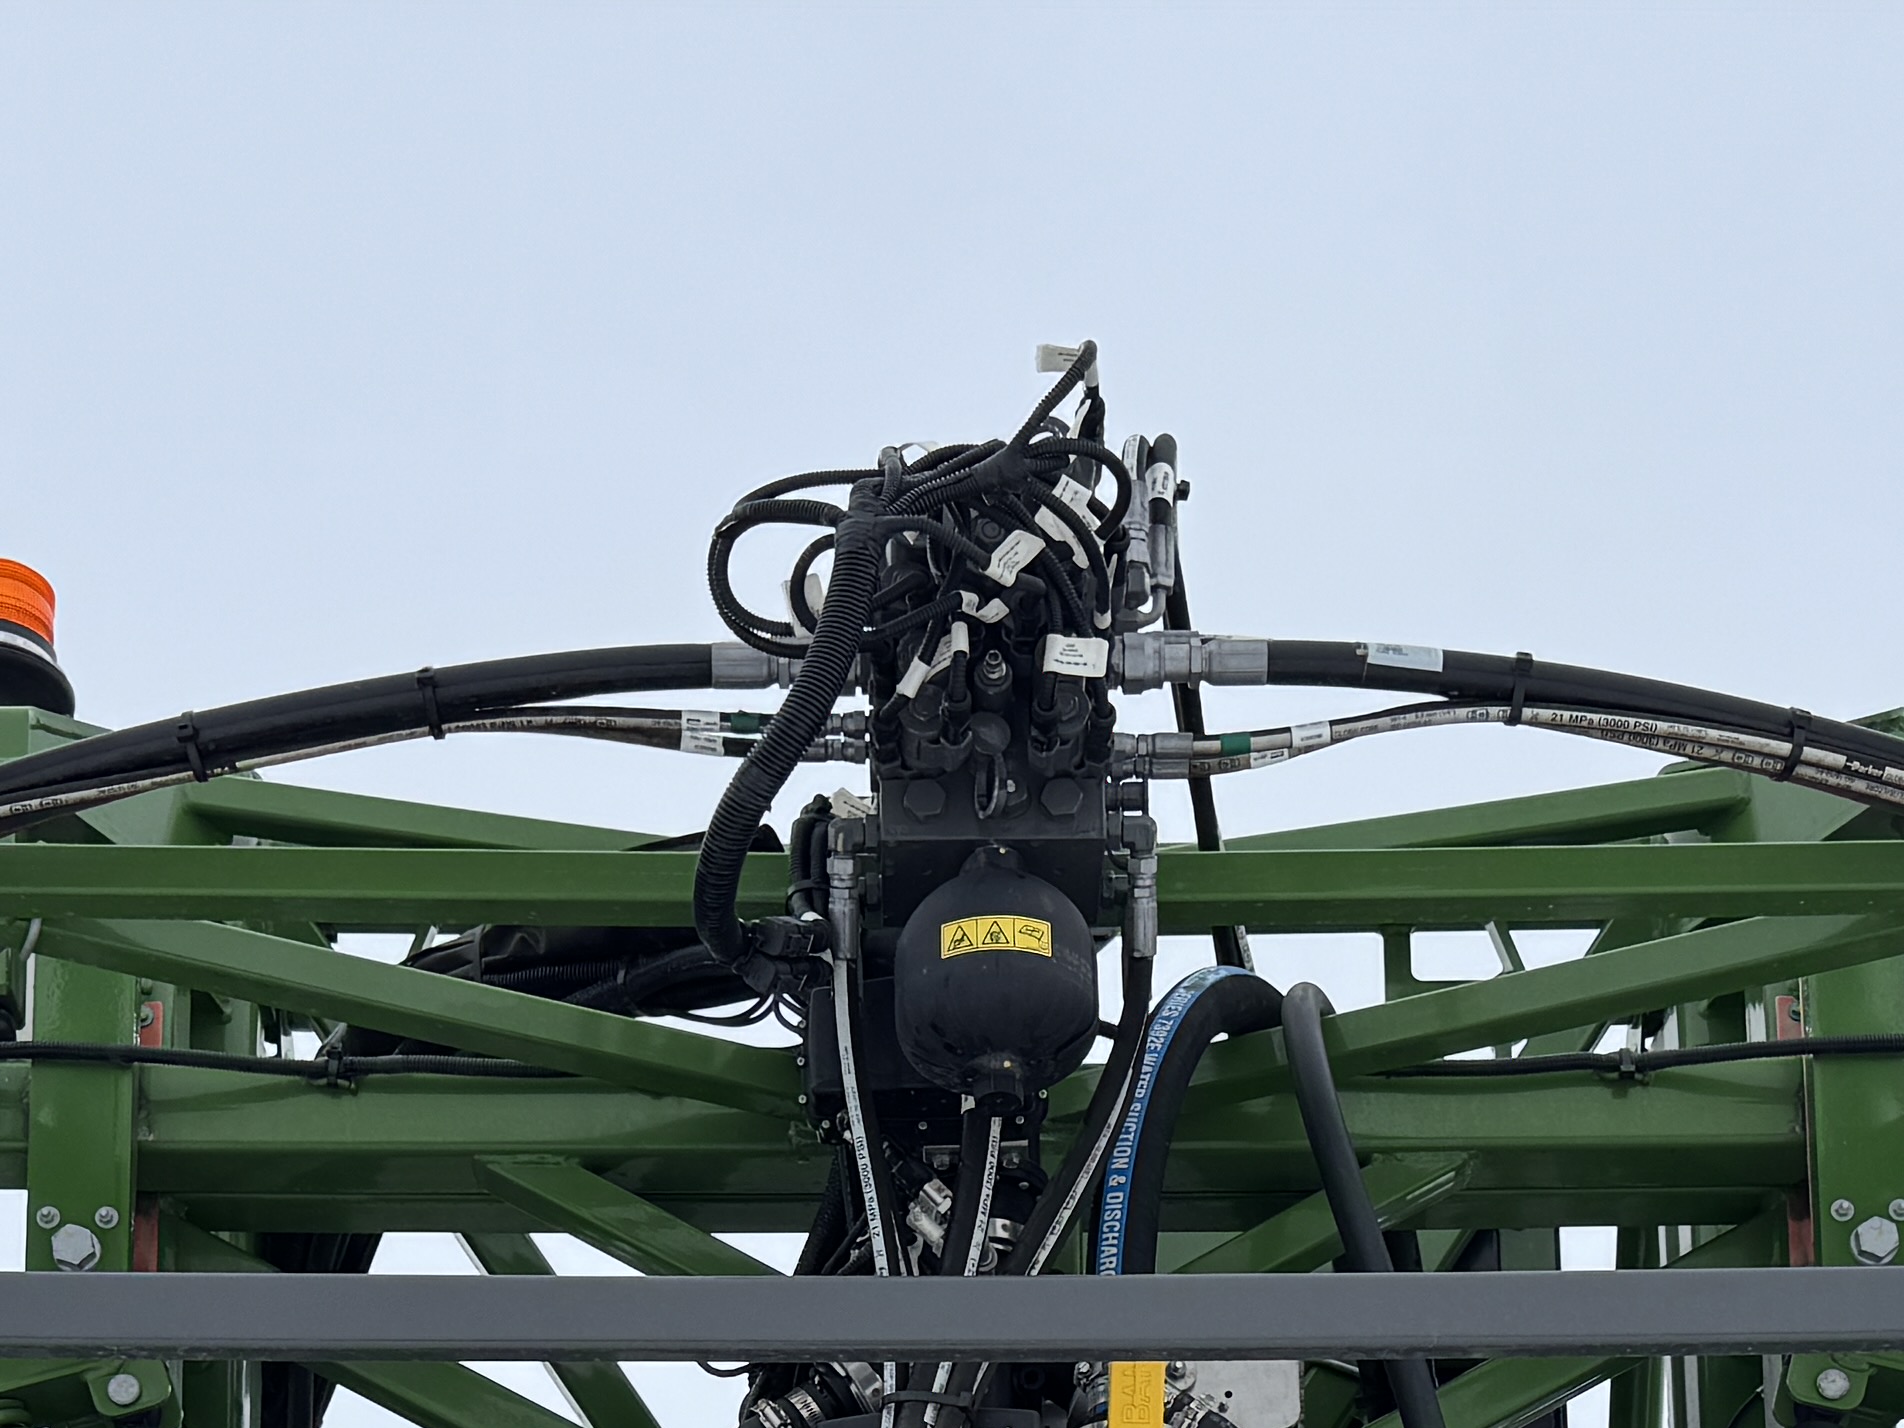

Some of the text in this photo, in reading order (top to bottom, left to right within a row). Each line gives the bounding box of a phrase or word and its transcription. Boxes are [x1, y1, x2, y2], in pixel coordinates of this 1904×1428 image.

[1551, 712, 1658, 734] 21 MPa (3000 PSI)
[1107, 1174, 1127, 1187] &
